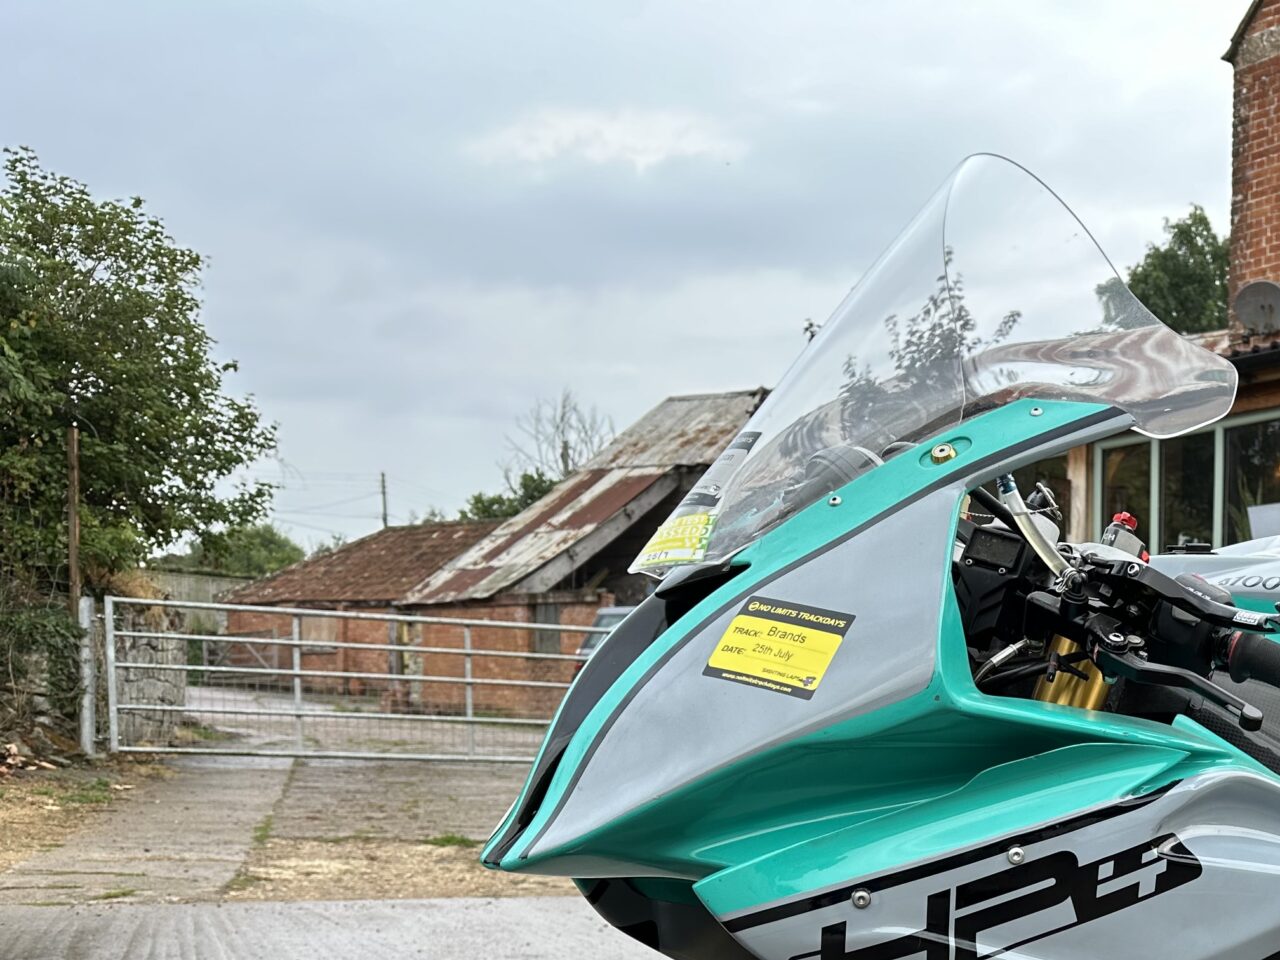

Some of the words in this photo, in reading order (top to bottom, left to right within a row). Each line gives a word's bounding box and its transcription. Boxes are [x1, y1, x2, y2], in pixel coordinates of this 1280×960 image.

[757, 603, 772, 612] NO
[771, 605, 797, 618] LIMITS
[798, 611, 847, 628] TRACKDAYS
[732, 626, 763, 638] TRACK:
[767, 626, 808, 644] Brands
[721, 644, 746, 655] DATE:
[752, 643, 773, 657] 25th
[774, 647, 794, 661] July
